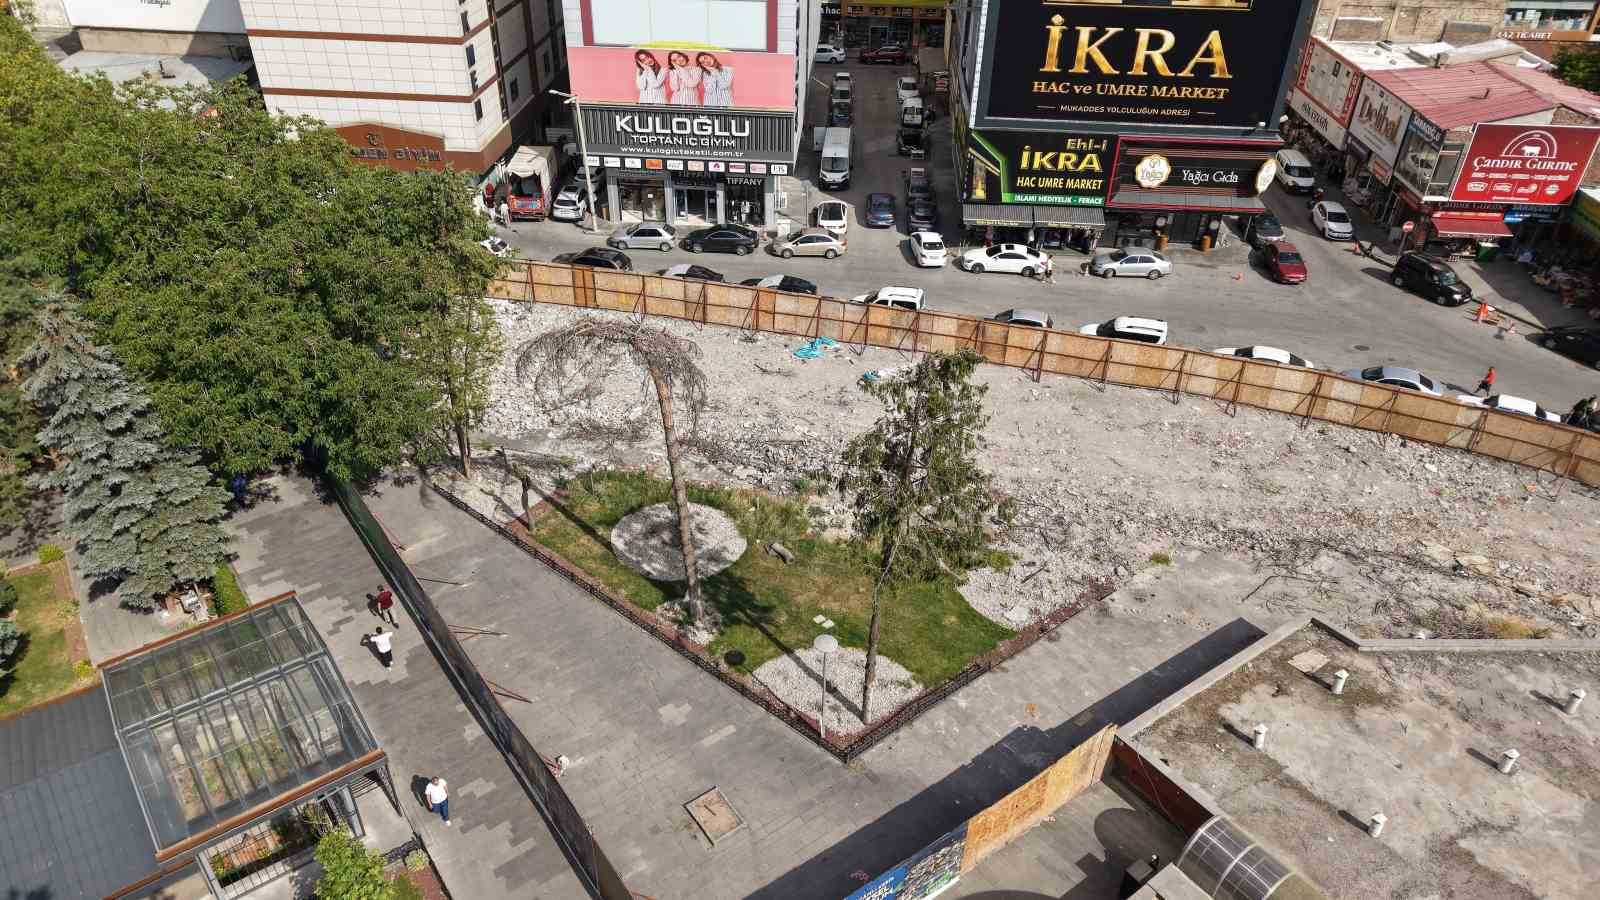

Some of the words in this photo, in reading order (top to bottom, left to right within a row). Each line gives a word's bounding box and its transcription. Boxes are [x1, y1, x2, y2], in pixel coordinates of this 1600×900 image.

[1039, 14, 1233, 79] İKRA
[1031, 81, 1071, 94] HAC
[1073, 83, 1093, 95] ve
[1096, 83, 1149, 97] UMRE
[1150, 85, 1230, 99] MARKET
[615, 114, 750, 137] KULOĞLU
[631, 135, 682, 146] TOPTAN
[1020, 145, 1104, 173] İKRA
[727, 177, 763, 186] TIFFANY
[1016, 176, 1036, 188] HAC
[1038, 177, 1064, 188] UMRE
[1065, 178, 1104, 190] MARKET
